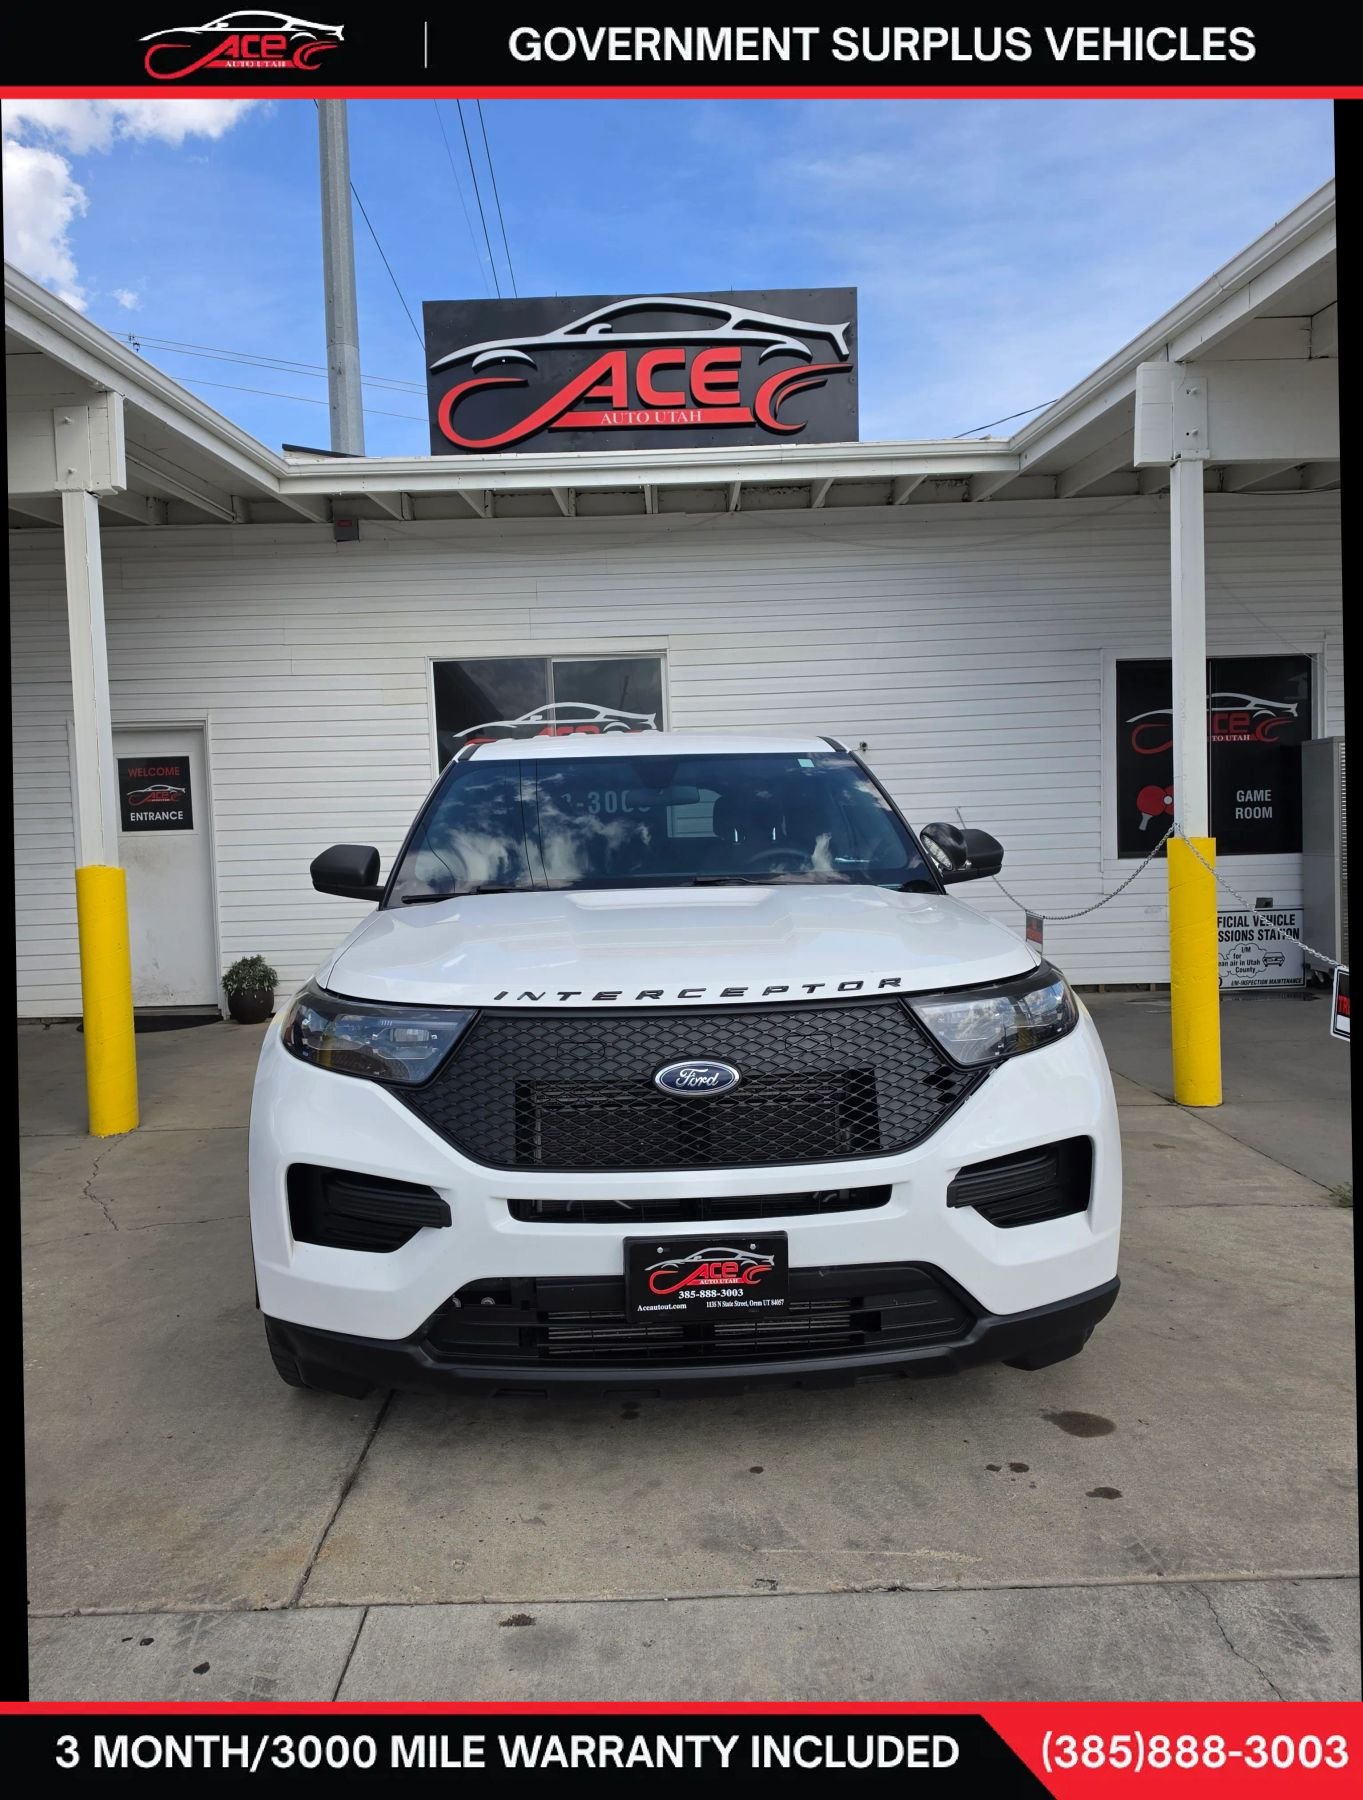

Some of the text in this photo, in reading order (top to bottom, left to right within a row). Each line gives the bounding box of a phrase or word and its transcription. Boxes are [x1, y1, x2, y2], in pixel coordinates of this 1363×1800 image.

[580, 346, 743, 410] ACE
[600, 409, 702, 426] AUTO UTAH
[1225, 734, 1251, 742] UTAH
[128, 767, 181, 777] WELCOME
[1236, 790, 1272, 803] GAME
[130, 811, 184, 822] ENTRANCE
[1235, 806, 1273, 820] ROOM
[1253, 914, 1296, 927] VEHICLE
[1235, 967, 1256, 975] County
[494, 977, 902, 1001] INTERCEPTOR
[675, 1068, 720, 1088] Ford
[678, 1288, 744, 1299] 385-888-3003
[637, 1303, 687, 1312] Aceautout.com
